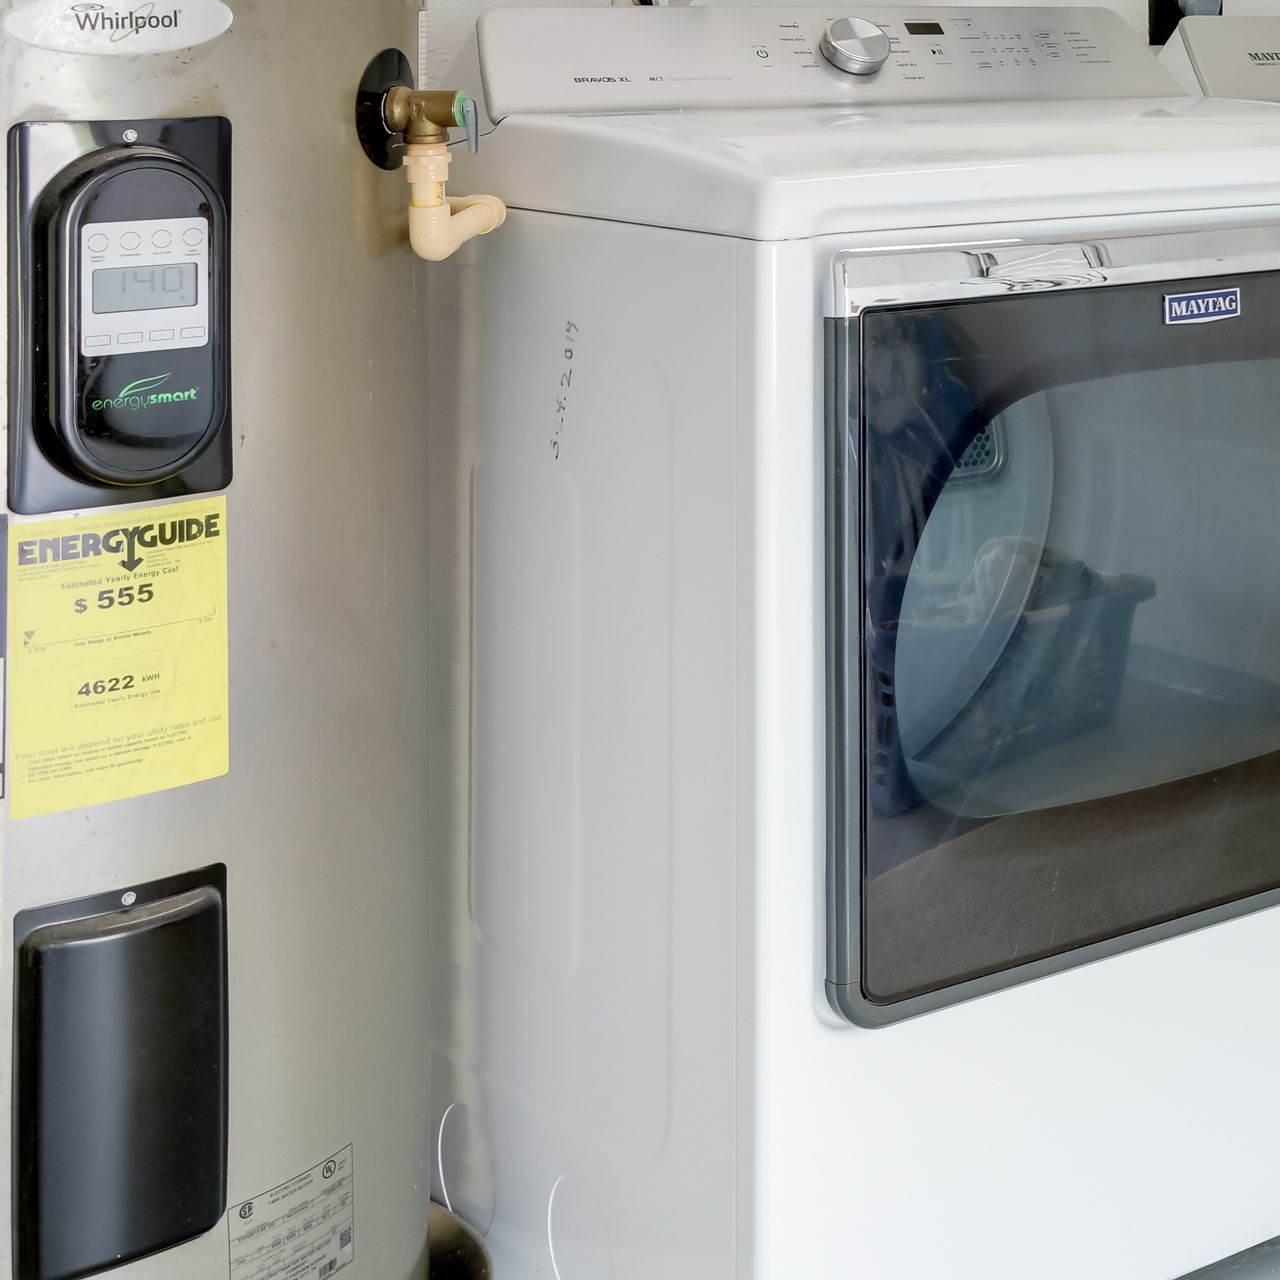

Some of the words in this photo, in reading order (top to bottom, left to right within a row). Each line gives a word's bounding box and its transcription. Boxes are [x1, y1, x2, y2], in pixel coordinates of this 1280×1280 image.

[75, 10, 178, 35] Whirlpool
[121, 266, 183, 294] 140
[1171, 295, 1236, 317] MAYTAG
[92, 388, 197, 411] energysmart
[18, 513, 220, 572] ENERGYGUIDE
[61, 578, 103, 590] Estimated
[105, 574, 131, 586] Yearly
[133, 569, 160, 580] Energy
[162, 566, 179, 575] Cost
[74, 598, 88, 614] $
[97, 583, 154, 609] 555
[77, 675, 135, 697] 4622
[74, 699, 105, 710] Estimated
[107, 696, 126, 706] Yearly
[127, 691, 148, 701] Energy
[15, 751, 36, 762] Your
[38, 746, 58, 757] cost
[60, 742, 75, 753] will
[77, 738, 111, 752] depend
[126, 732, 146, 743] your
[147, 726, 168, 738] utility
[170, 721, 190, 732] rates
[192, 718, 207, 727] and
[208, 714, 222, 722] use
